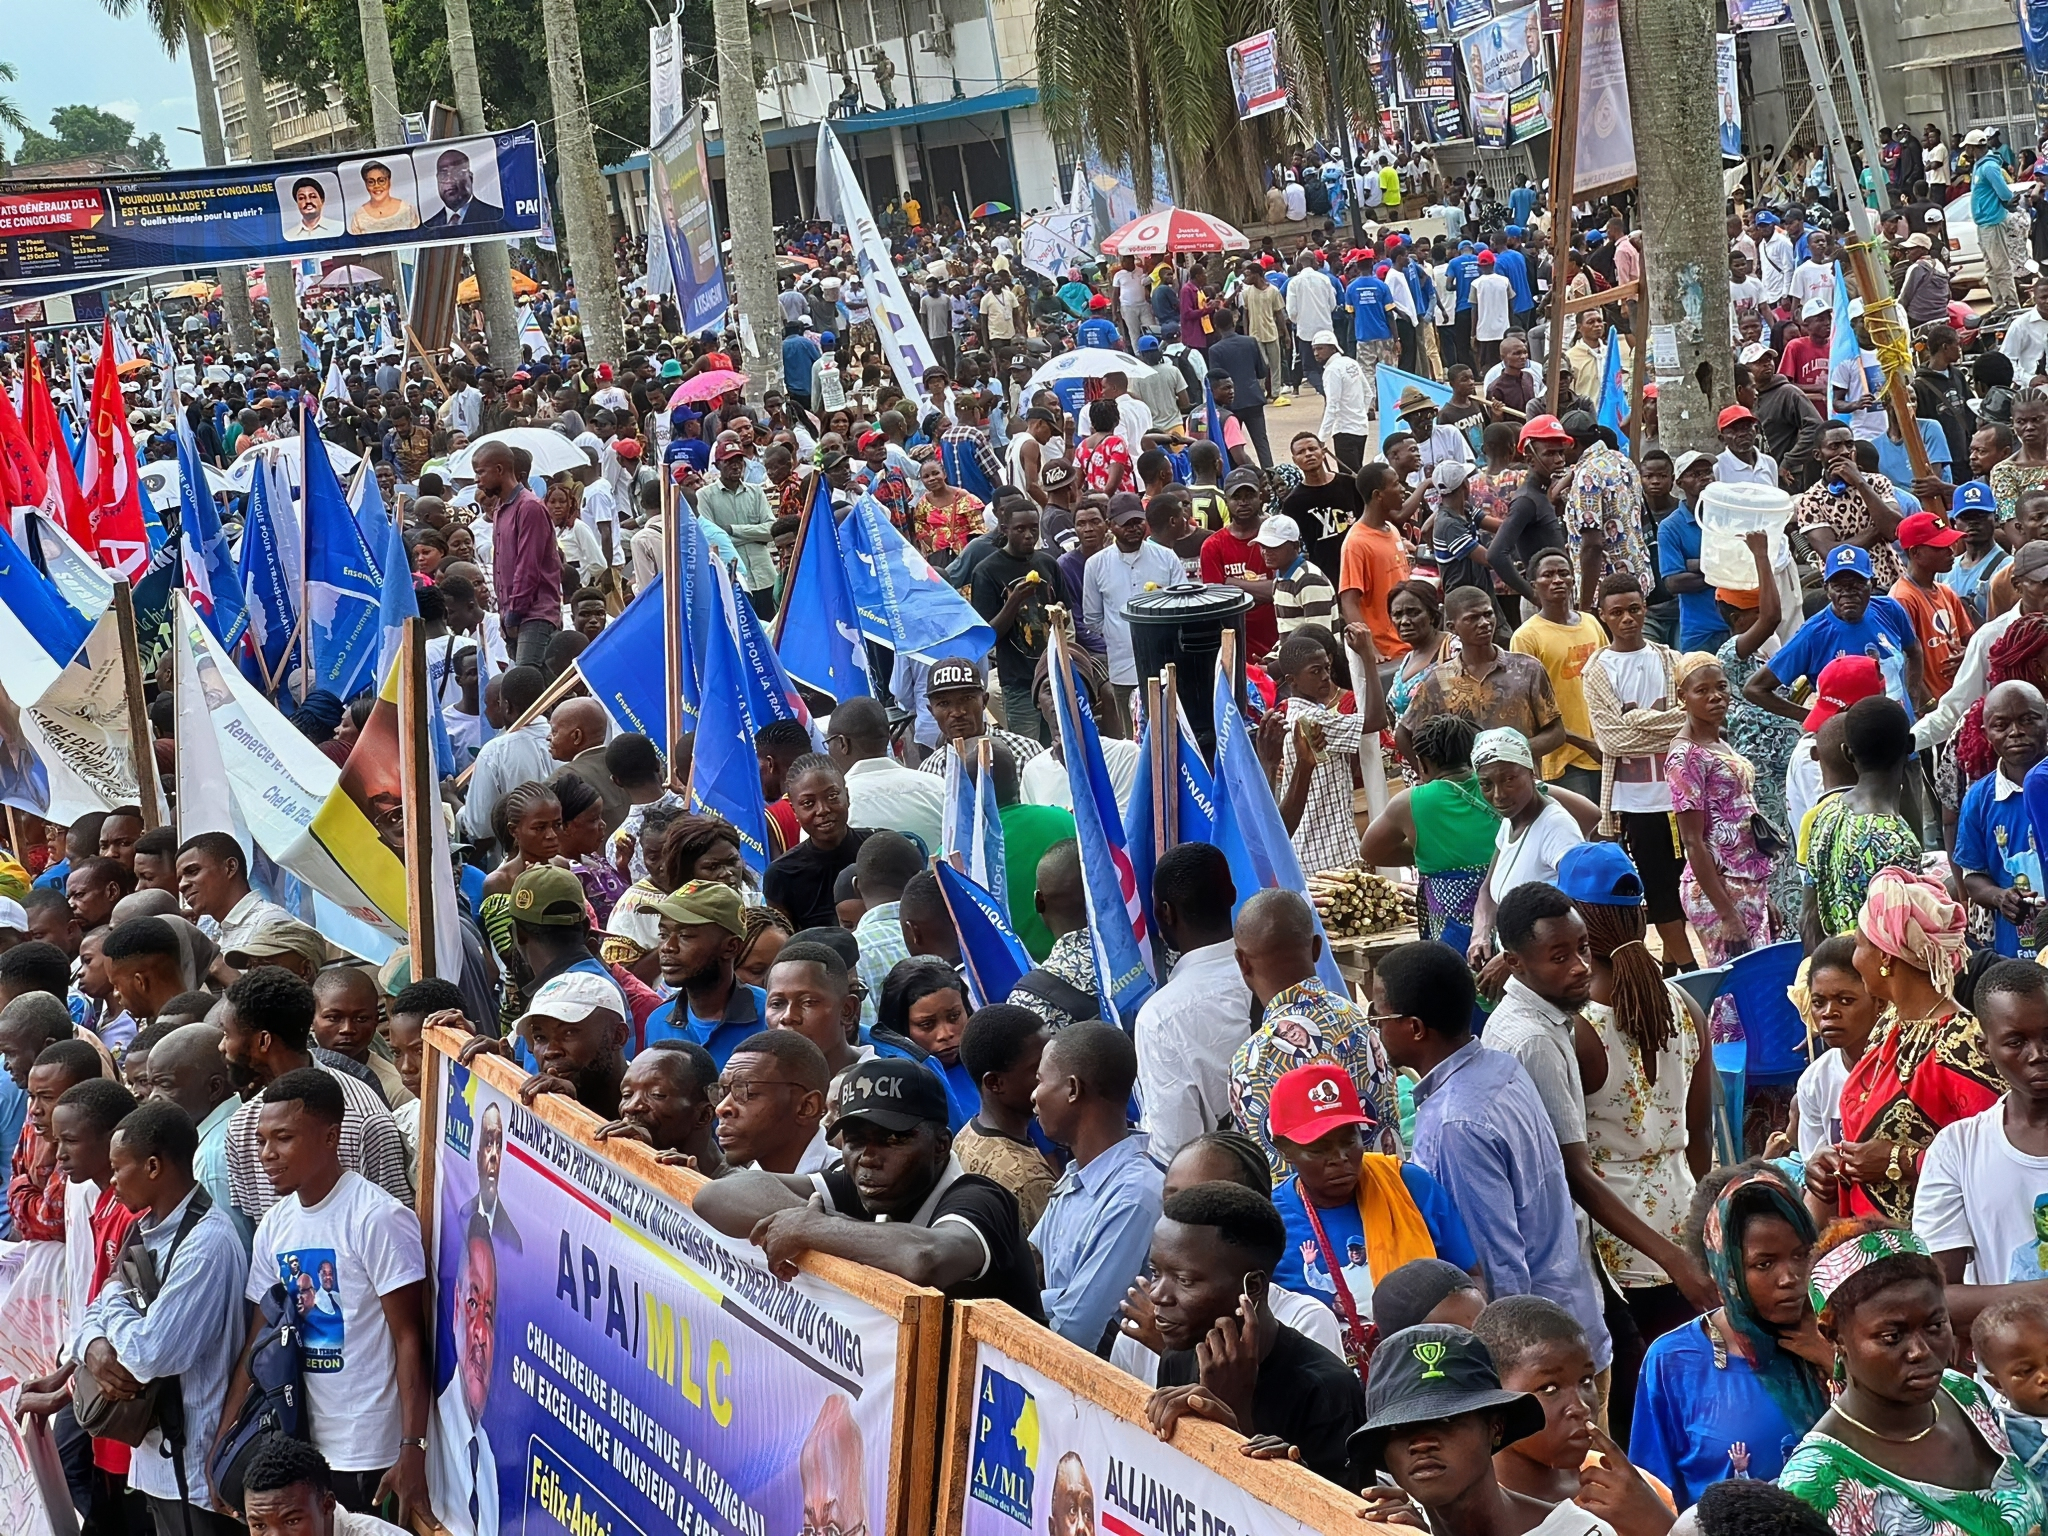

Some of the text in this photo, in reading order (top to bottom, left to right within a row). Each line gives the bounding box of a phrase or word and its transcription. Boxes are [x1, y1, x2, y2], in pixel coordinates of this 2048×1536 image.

[72, 198, 84, 210] DE
[86, 198, 99, 208] LA
[119, 183, 274, 205] POURQUOI LA JUSTICE CONGOLAISE
[13, 213, 73, 227] CONGOLAISE
[121, 204, 163, 217] EST-ELLE
[164, 203, 201, 214] MALADE
[140, 215, 167, 227] Quelle
[168, 213, 203, 225] thérapie
[204, 212, 223, 223] pour
[223, 210, 232, 219] la
[232, 208, 257, 220] guérir
[1128, 244, 1157, 253] vodacom
[259, 523, 272, 551] POUR
[266, 550, 275, 566] LA
[745, 641, 764, 674] POUR
[759, 674, 771, 691] LA
[933, 665, 973, 686] CHO.2
[614, 692, 647, 736] Ensemble
[72, 734, 95, 751] DE
[90, 741, 109, 758] LA
[223, 718, 276, 765] Remercie
[262, 784, 281, 807] Chef
[281, 797, 294, 815] de
[508, 1100, 552, 1160] ALLIANCE
[551, 1134, 572, 1171] DES
[572, 1145, 604, 1196] PARTIS
[601, 1165, 638, 1219] ALLIES
[634, 1187, 651, 1230] AU
[649, 1197, 719, 1275] MOUVEMENT
[717, 1243, 736, 1288] DE
[796, 1297, 817, 1346] DU
[816, 1310, 864, 1378] CONGO
[982, 1376, 995, 1404] A
[526, 1321, 766, 1536] CHALEUREUSE BIENVENUE A KISANGANI
[980, 1414, 992, 1442] P
[512, 1354, 536, 1398] SON
[537, 1375, 610, 1462] EXCELLENCE
[612, 1437, 677, 1521] MONSIEUR
[676, 1495, 694, 1535] LE
[972, 1485, 1000, 1509] Alliance
[973, 1457, 1031, 1510] A/ML
[1104, 1455, 1198, 1536] ALLIANCE
